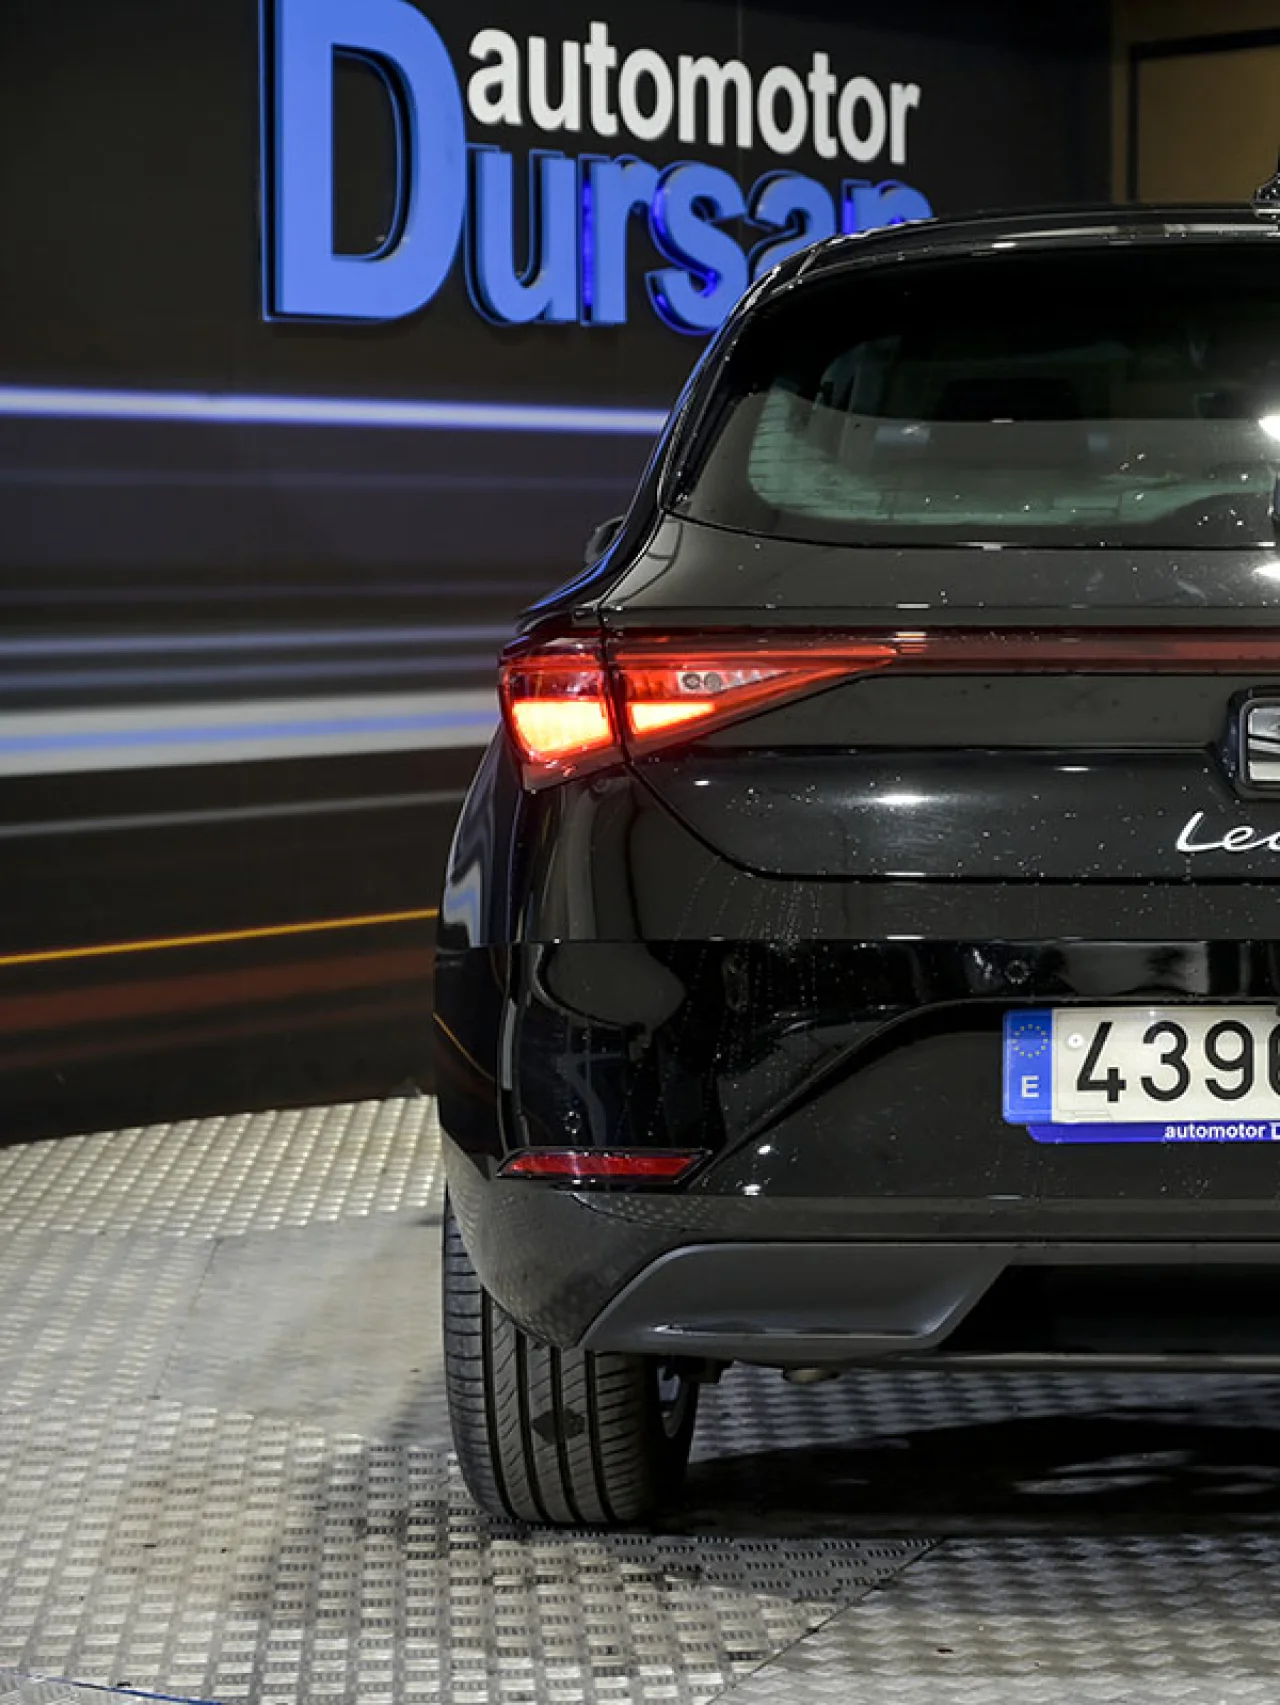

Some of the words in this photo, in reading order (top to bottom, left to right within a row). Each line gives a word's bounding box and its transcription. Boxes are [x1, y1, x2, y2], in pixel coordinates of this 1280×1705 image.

[467, 21, 921, 165] automotor
[1020, 1074, 1040, 1098] E
[1164, 1122, 1267, 1139] automotor
